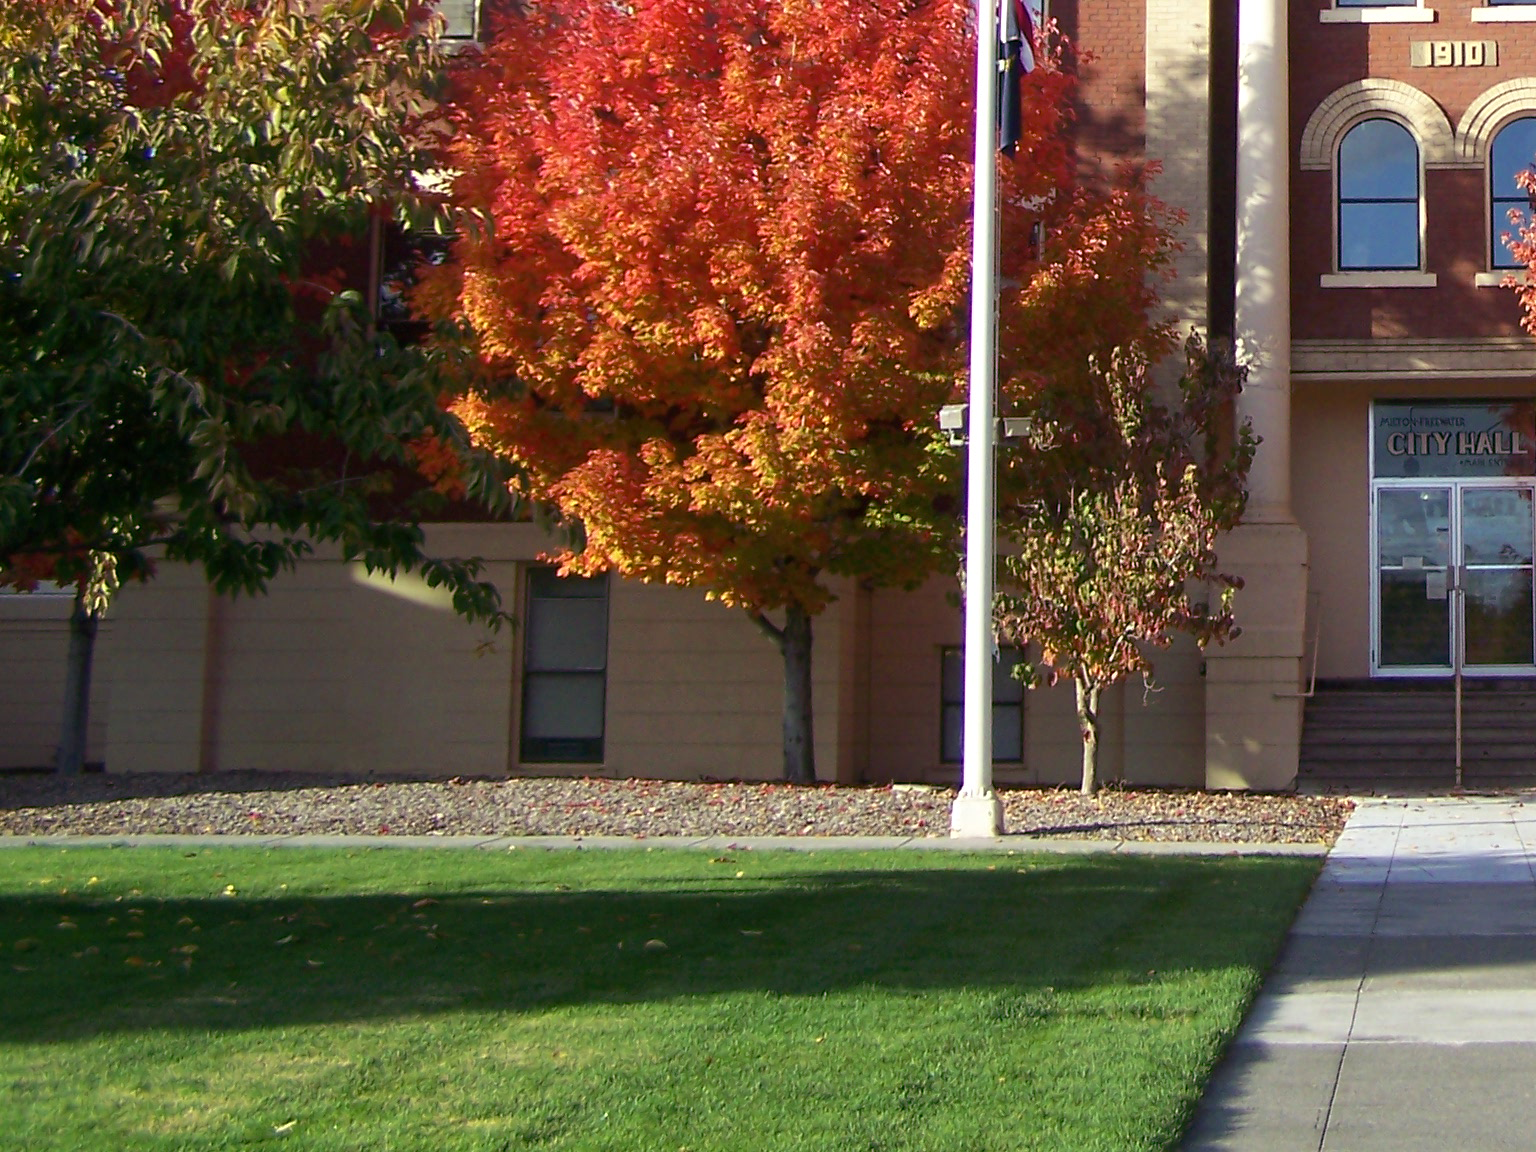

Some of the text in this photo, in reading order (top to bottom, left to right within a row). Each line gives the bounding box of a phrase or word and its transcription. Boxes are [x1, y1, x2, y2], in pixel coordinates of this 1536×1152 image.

[1424, 41, 1483, 66] 1910
[1387, 431, 1528, 455] CITY HALL
